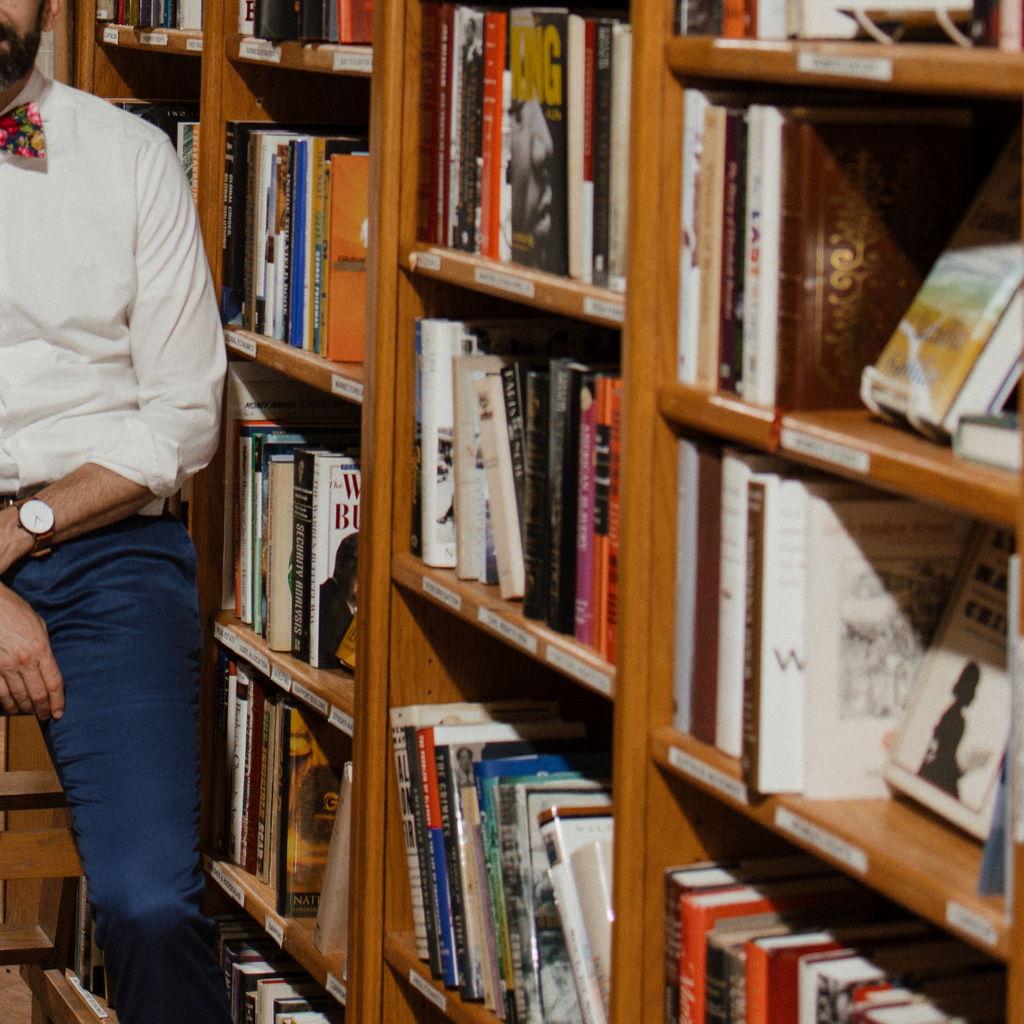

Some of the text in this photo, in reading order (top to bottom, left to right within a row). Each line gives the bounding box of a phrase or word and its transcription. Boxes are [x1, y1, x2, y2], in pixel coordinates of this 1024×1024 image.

[328, 480, 343, 489] The
[294, 523, 304, 635] SECURITY ANALYSIS
[436, 754, 445, 779] THE
